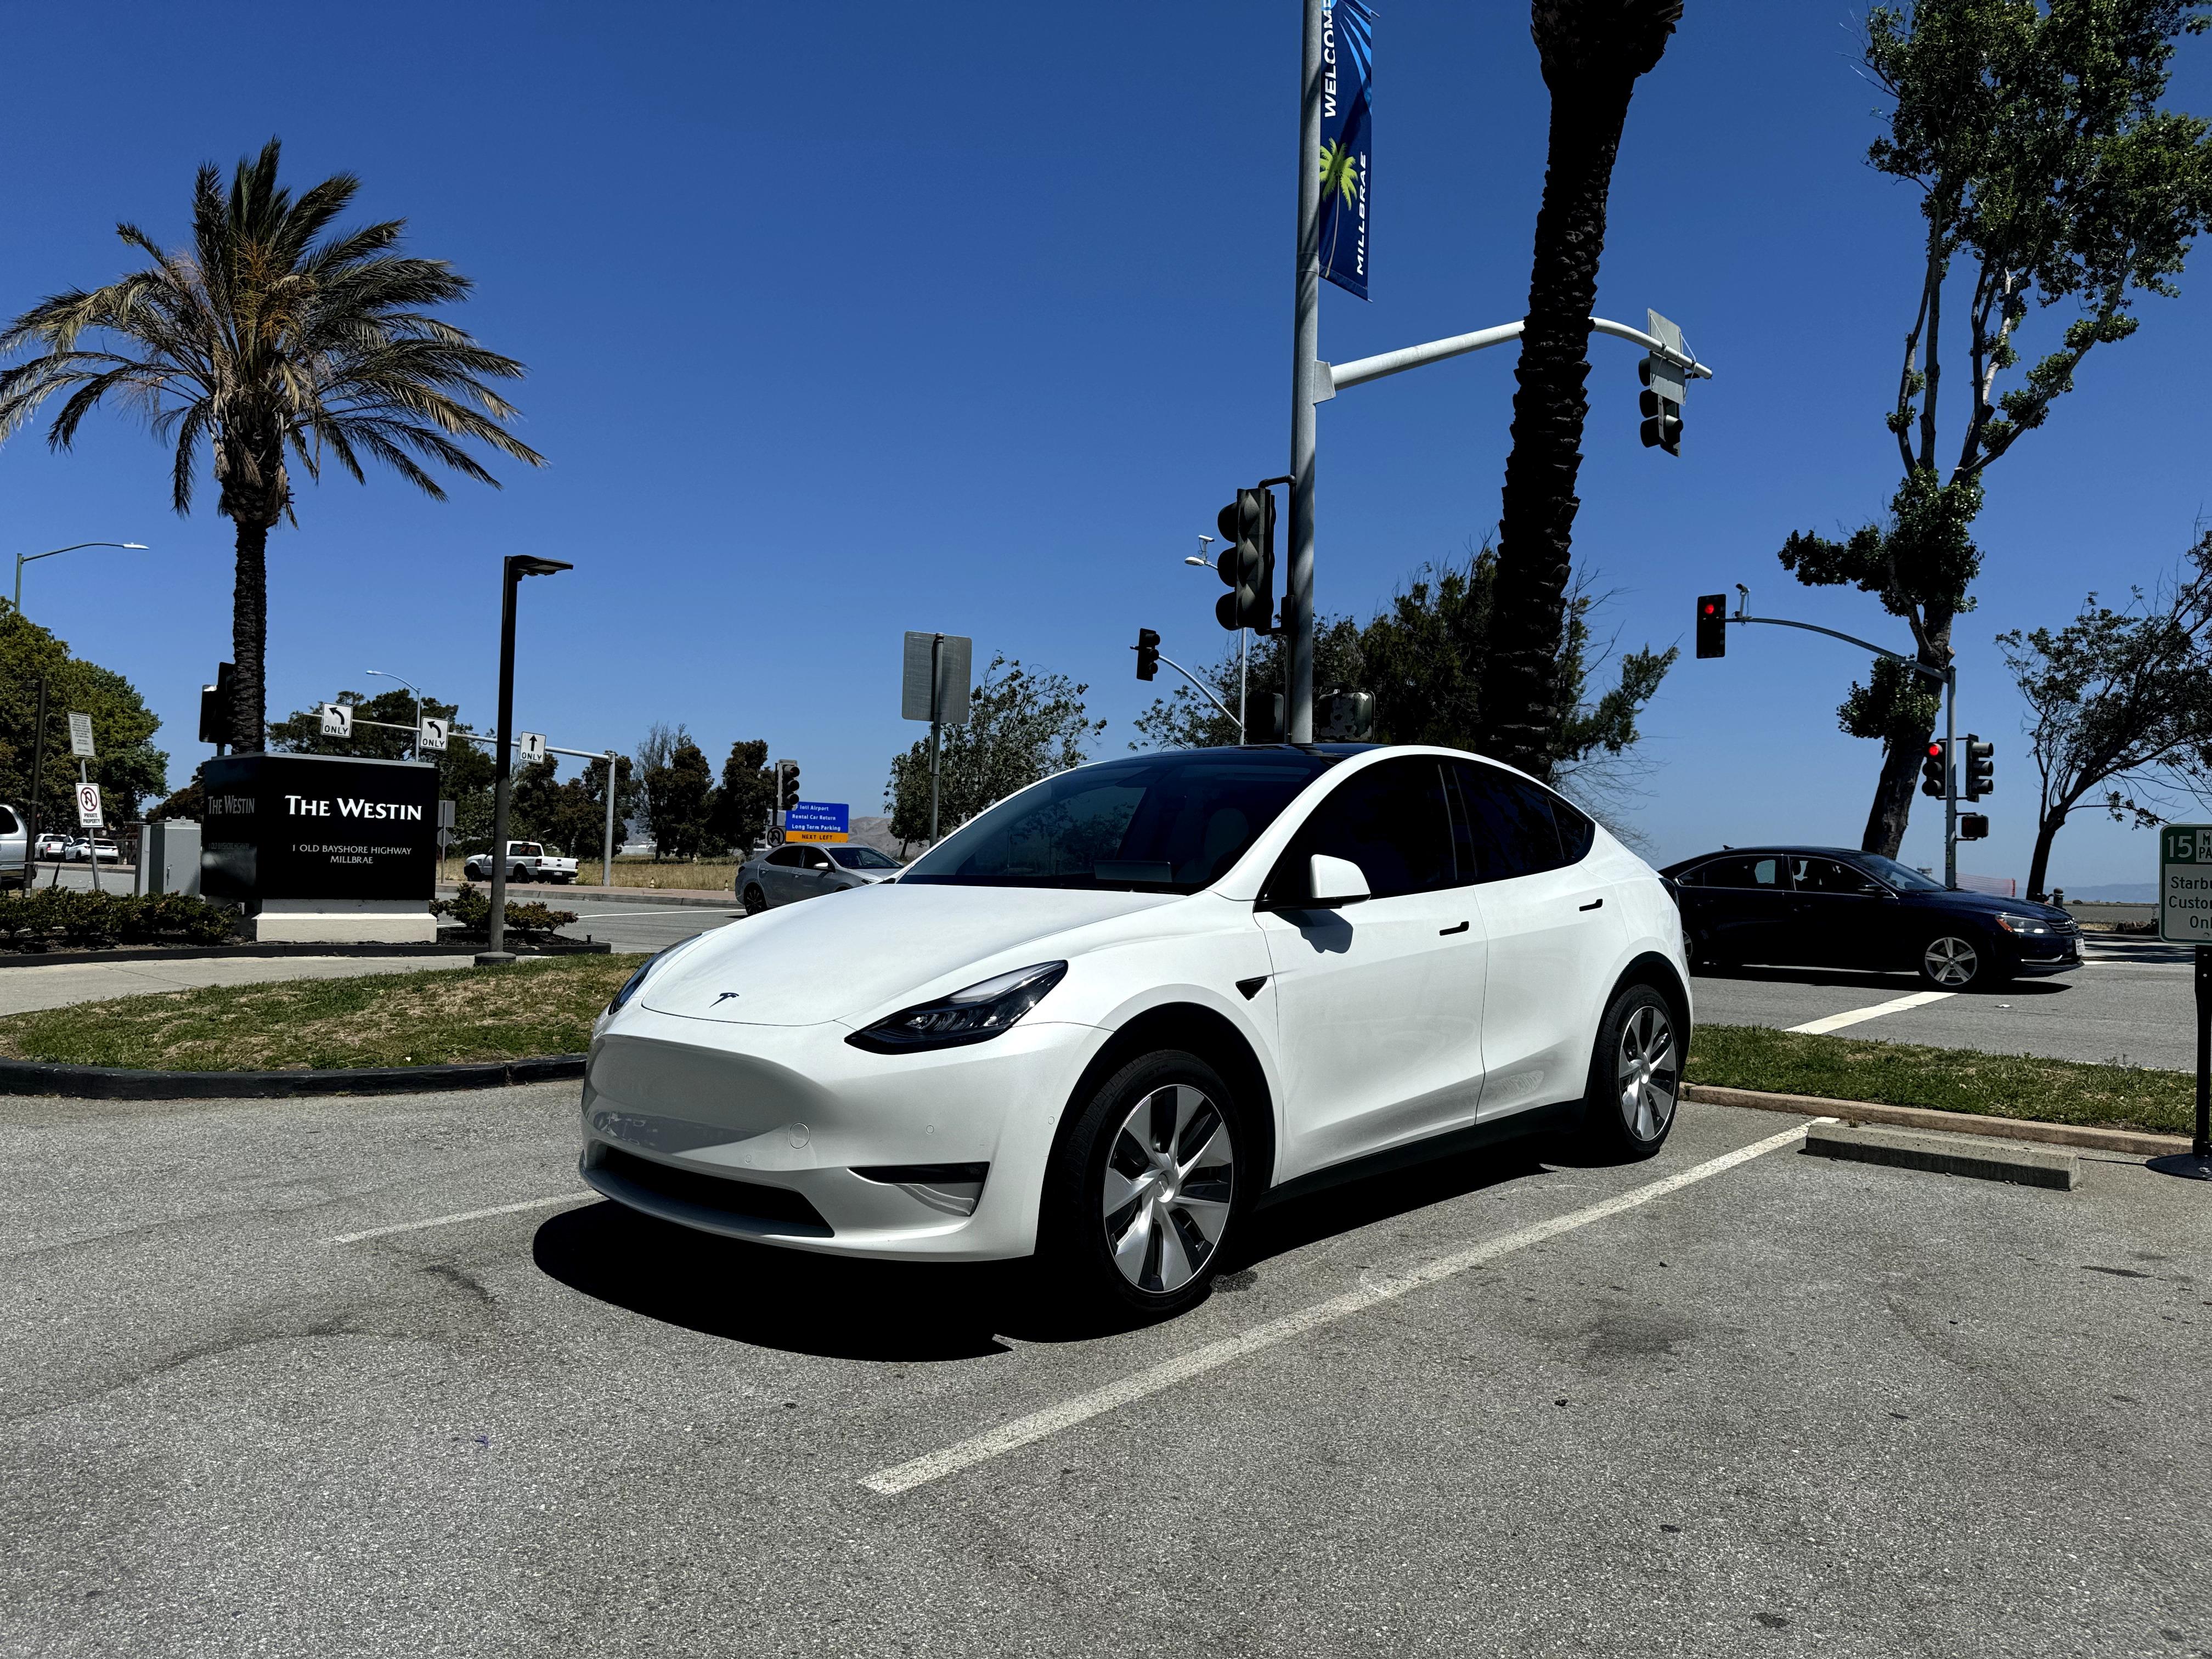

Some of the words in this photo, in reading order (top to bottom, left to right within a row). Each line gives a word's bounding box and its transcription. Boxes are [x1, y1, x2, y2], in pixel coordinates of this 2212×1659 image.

[1357, 151, 1366, 275] MILLBRAE
[324, 725, 348, 735] ONLY
[422, 738, 445, 748] ONLY
[522, 752, 542, 761] ONLY
[285, 795, 331, 816] THE
[336, 798, 422, 821] WESTIN
[300, 844, 319, 852] OLD
[322, 845, 368, 854] BAYSHORE
[371, 846, 411, 855] HIGHWAY
[2168, 835, 2193, 858] 15
[330, 855, 374, 864] MILLBRAE
[2170, 876, 2212, 890] Starb
[2169, 895, 2212, 910] Custo
